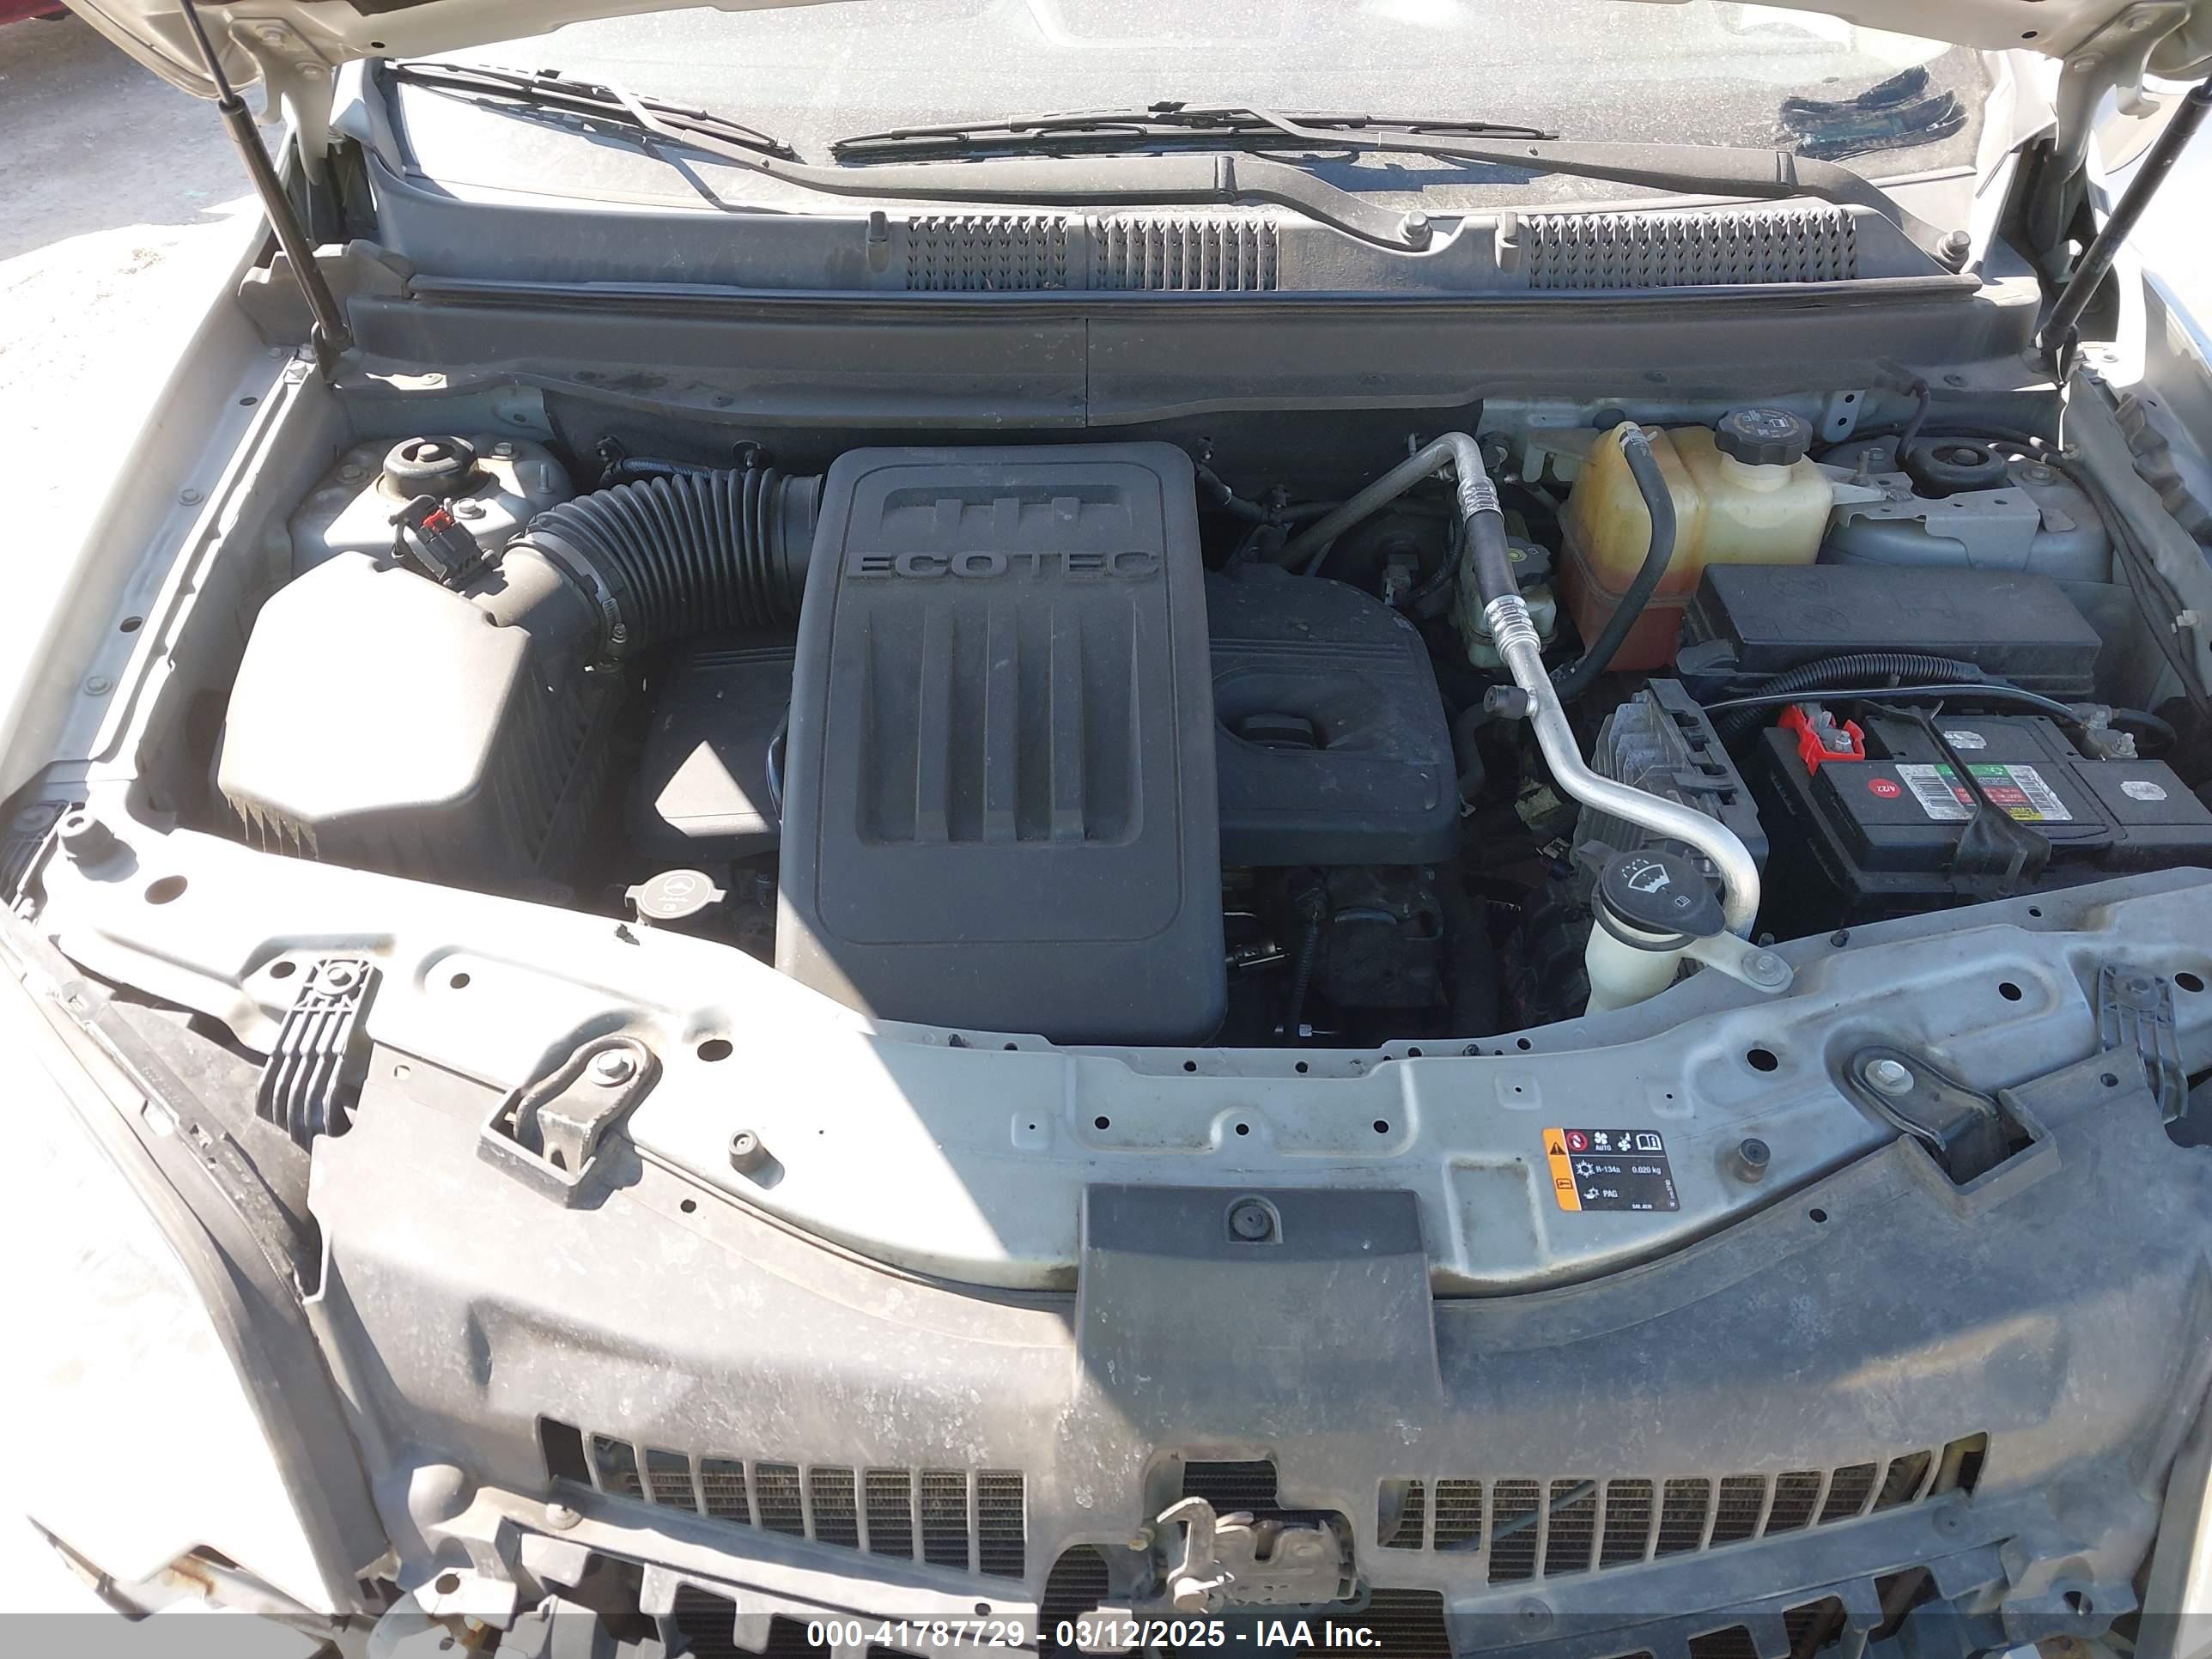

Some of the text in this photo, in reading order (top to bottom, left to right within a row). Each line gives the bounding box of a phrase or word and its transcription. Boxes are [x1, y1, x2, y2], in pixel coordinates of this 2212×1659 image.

[846, 550, 1161, 579] ECOTEC
[1595, 1165, 1621, 1174] R-134a
[1652, 1165, 1662, 1176] kg
[1602, 1189, 1619, 1199] PAG
